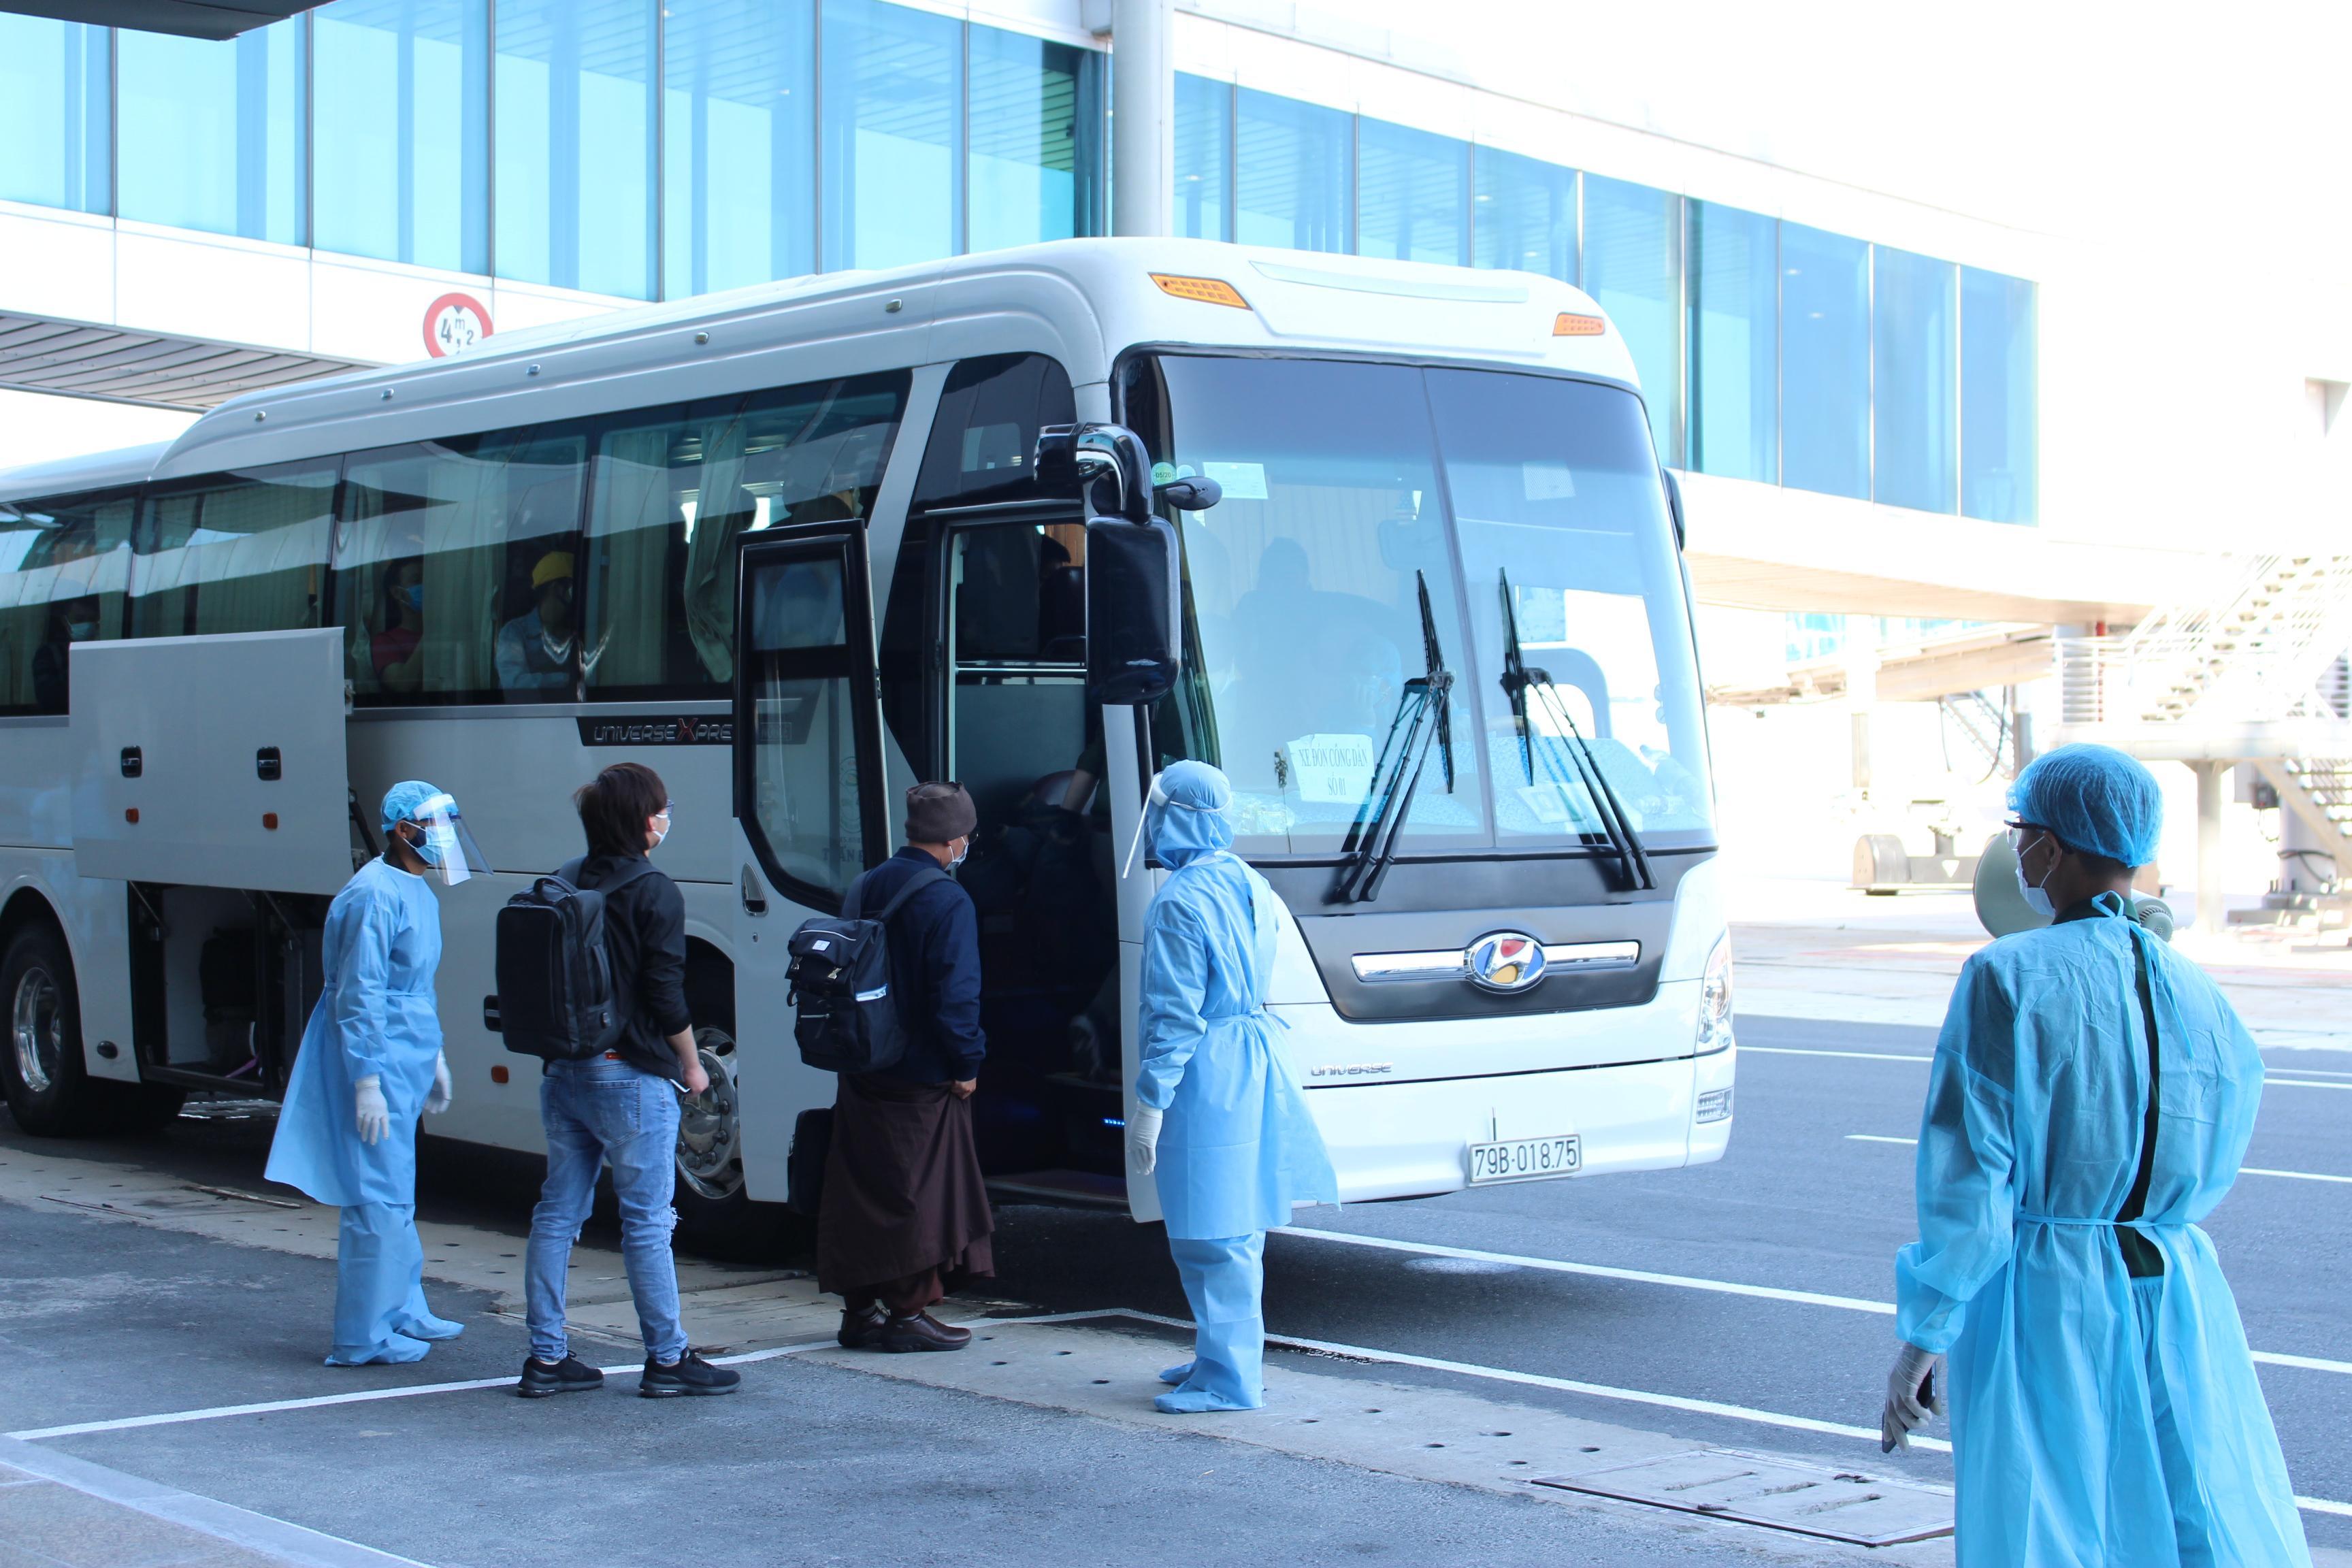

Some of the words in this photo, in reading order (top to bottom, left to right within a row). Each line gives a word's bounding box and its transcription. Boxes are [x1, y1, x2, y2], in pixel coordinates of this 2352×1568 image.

[593, 717, 733, 742] UNIVERSEXPRE
[1298, 748, 1312, 767] XE
[1312, 742, 1328, 767] ĐÓN
[1329, 742, 1351, 768] CÔNG
[1352, 742, 1369, 768] DÂN
[1339, 777, 1347, 796] 01
[1311, 1061, 1394, 1077] UNIVERSE
